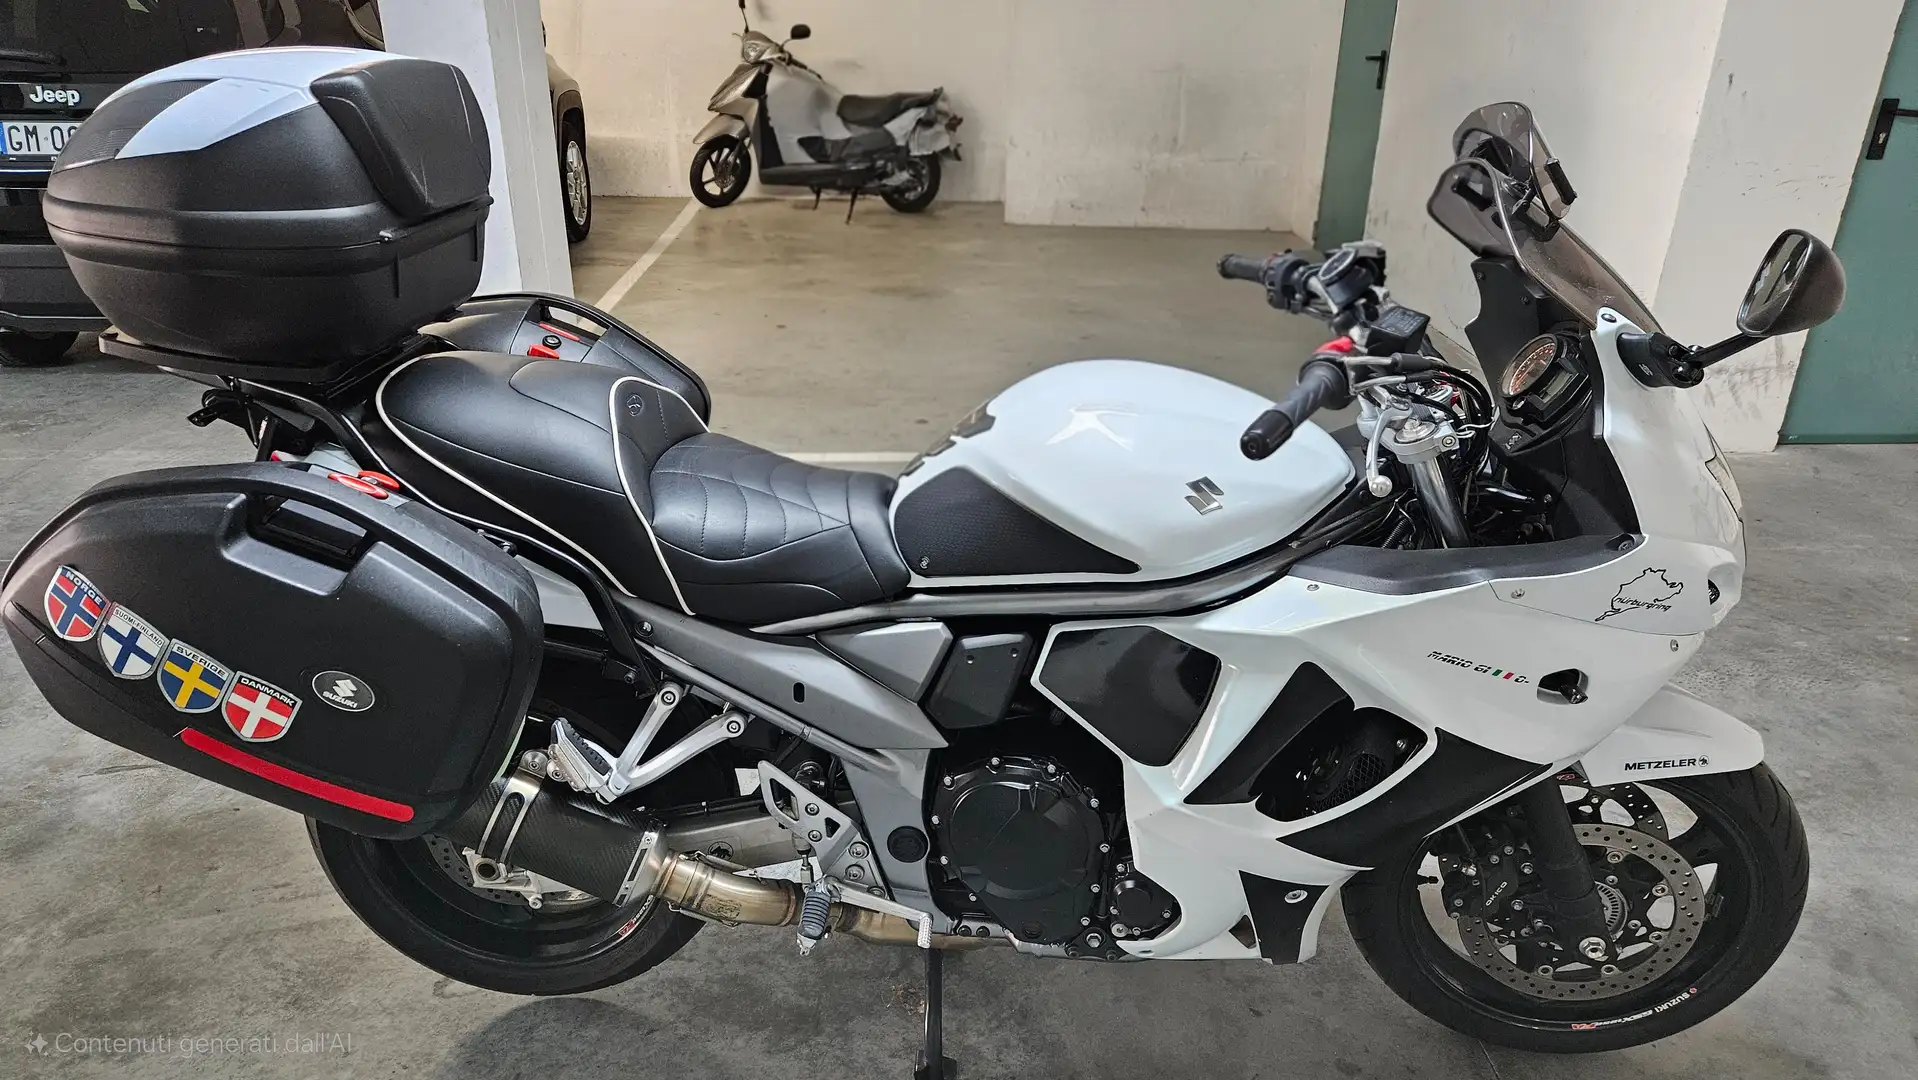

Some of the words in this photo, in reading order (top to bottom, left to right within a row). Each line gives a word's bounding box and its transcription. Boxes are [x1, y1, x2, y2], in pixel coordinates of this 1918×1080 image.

[29, 85, 80, 106] Jeep
[7, 125, 41, 152] GM
[65, 570, 103, 606] NORGE
[176, 645, 226, 677] SVERIGE
[240, 677, 296, 707] DANMARK
[322, 690, 358, 708] SUZUKI
[1624, 758, 1697, 771] METZELER
[1485, 881, 1508, 907] OKICO
[1654, 992, 1690, 1013] SUZUKI
